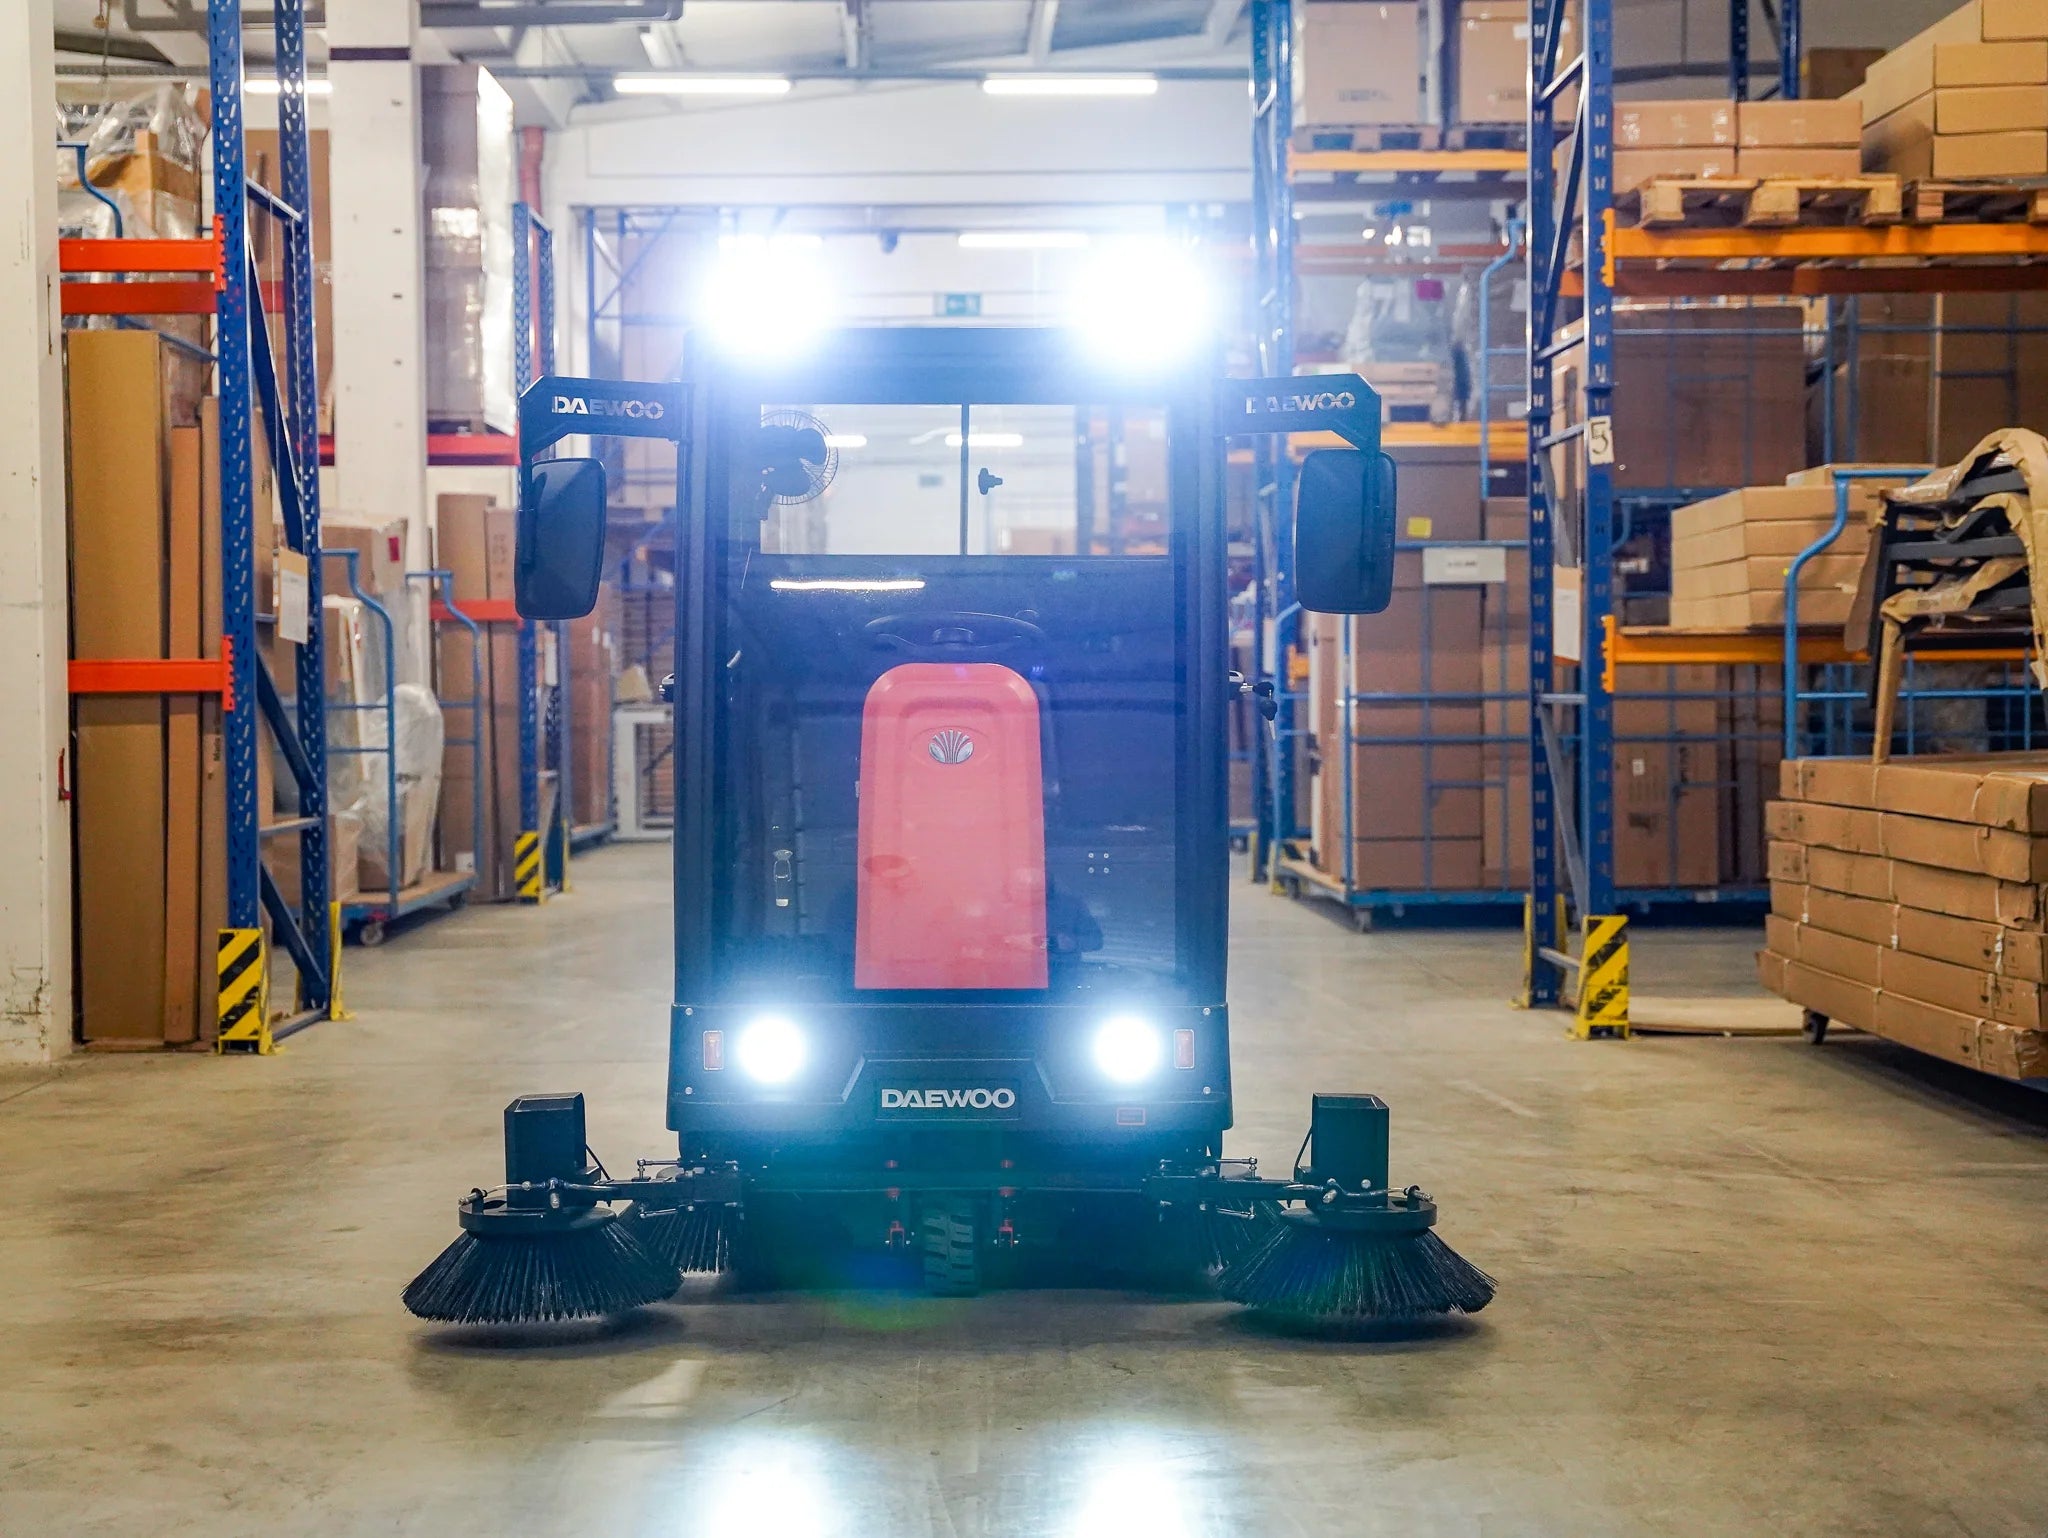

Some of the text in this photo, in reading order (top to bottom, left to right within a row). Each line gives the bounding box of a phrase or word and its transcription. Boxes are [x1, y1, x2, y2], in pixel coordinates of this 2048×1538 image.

[551, 396, 665, 420] DAEWOO
[1590, 421, 1609, 455] 5
[881, 1087, 1016, 1109] DAEWOO
